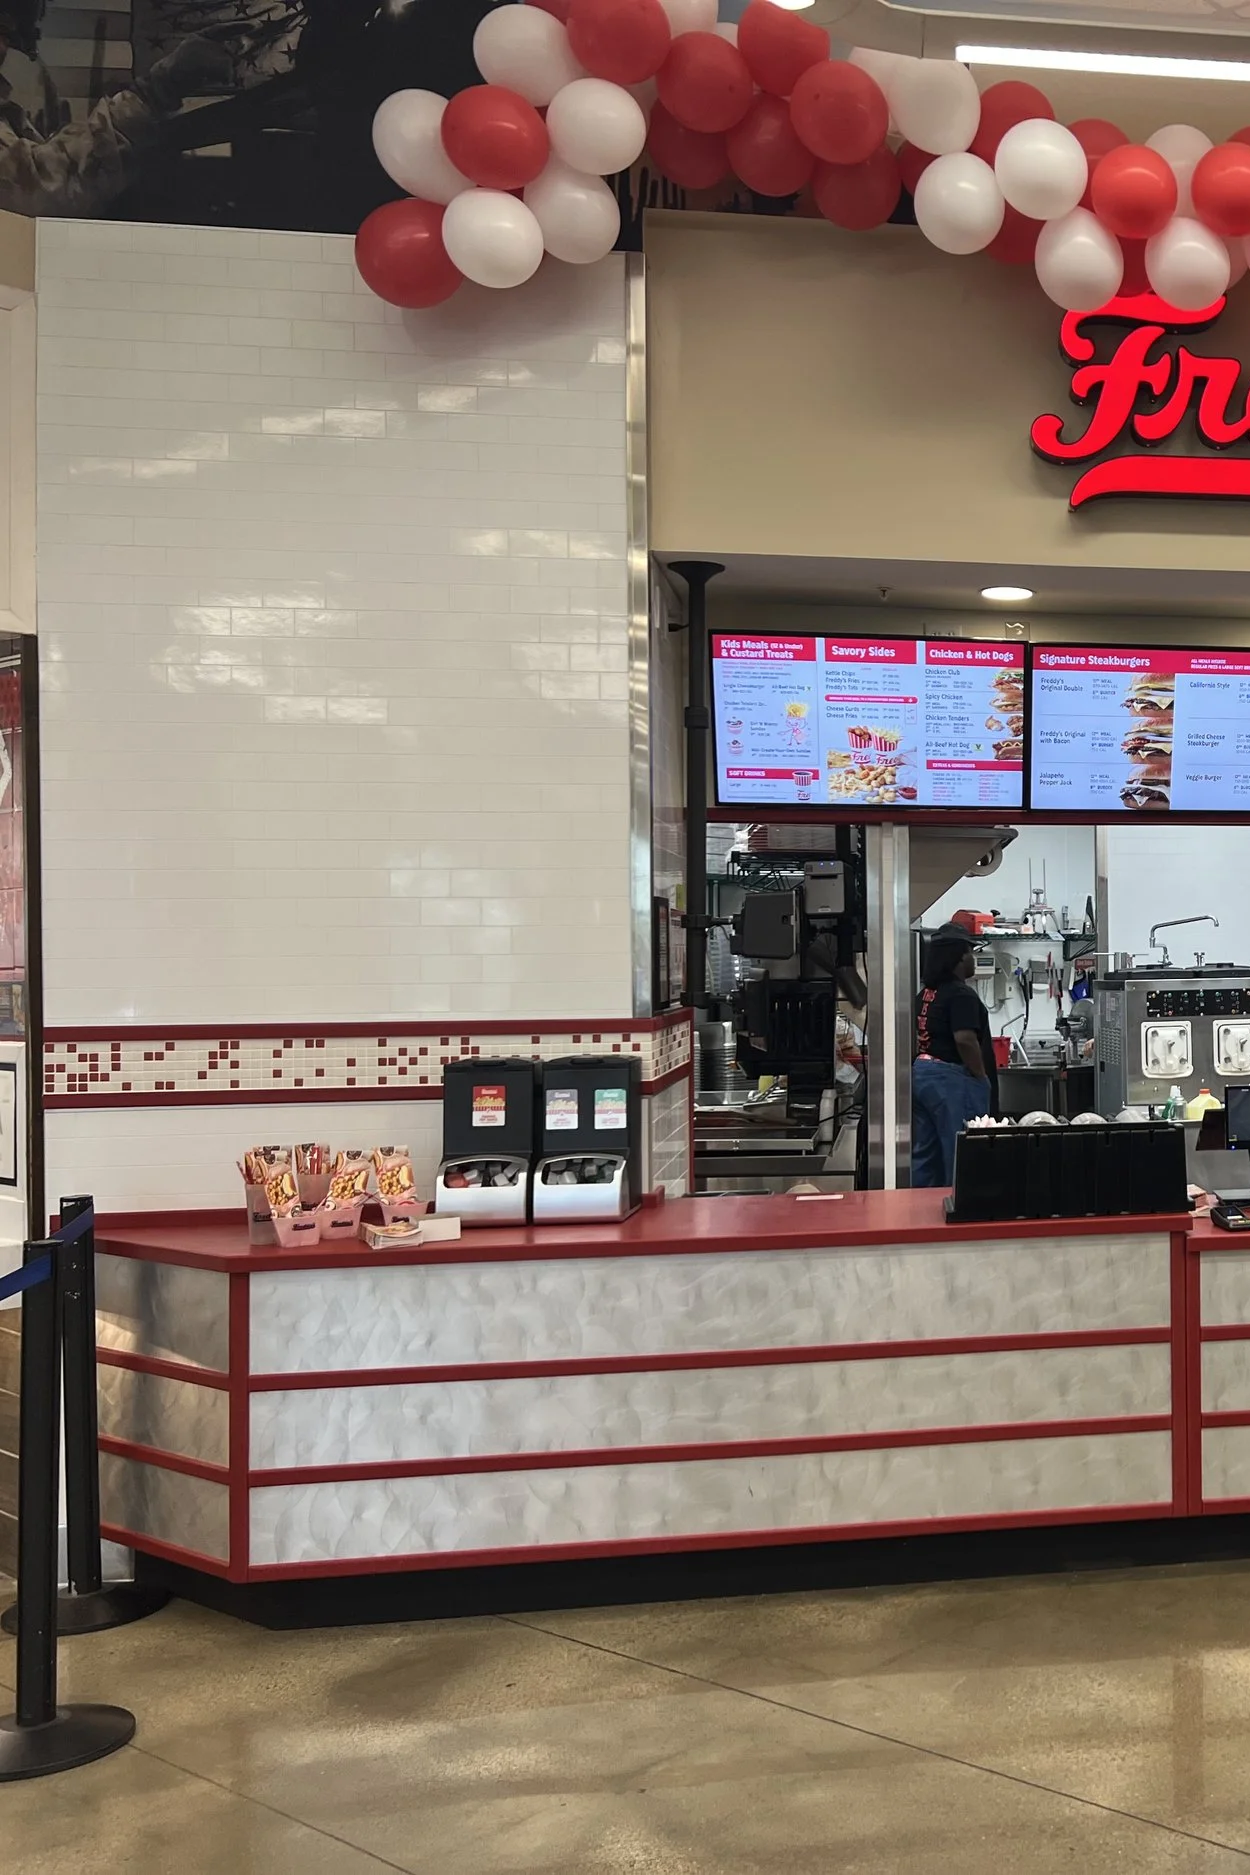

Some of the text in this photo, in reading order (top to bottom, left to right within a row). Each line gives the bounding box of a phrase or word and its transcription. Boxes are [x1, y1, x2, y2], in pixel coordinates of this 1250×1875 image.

[721, 640, 740, 648] Kids
[743, 641, 769, 649] Meals
[721, 649, 728, 657] &
[730, 649, 764, 657] Custard
[831, 646, 895, 658] Savory Sides
[930, 649, 964, 658] Chicken
[992, 652, 1014, 662] Dogs
[1040, 654, 1150, 668] Signature Steakburgers
